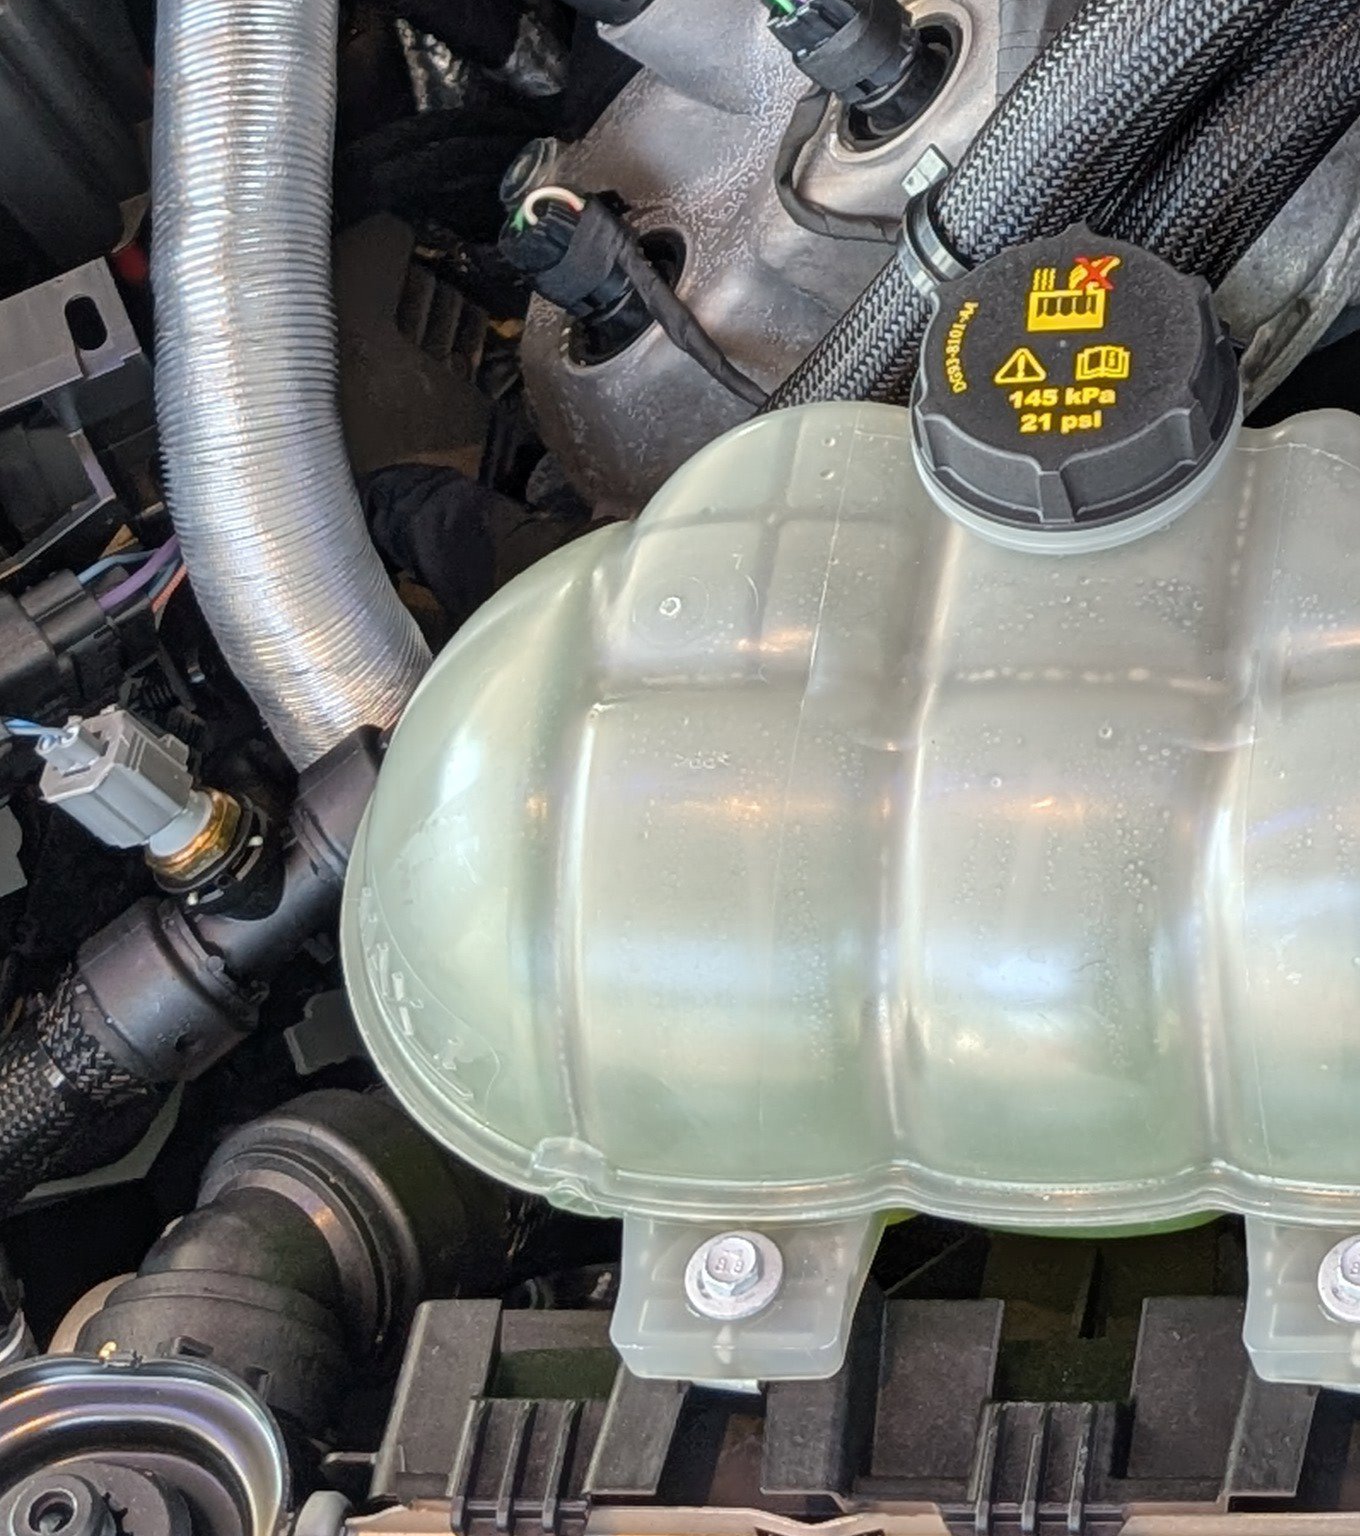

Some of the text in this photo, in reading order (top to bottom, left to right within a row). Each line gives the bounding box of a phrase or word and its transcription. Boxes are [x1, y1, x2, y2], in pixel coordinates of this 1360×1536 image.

[1008, 387, 1116, 409] 145 kPa
[1019, 409, 1103, 434] 21 psi
